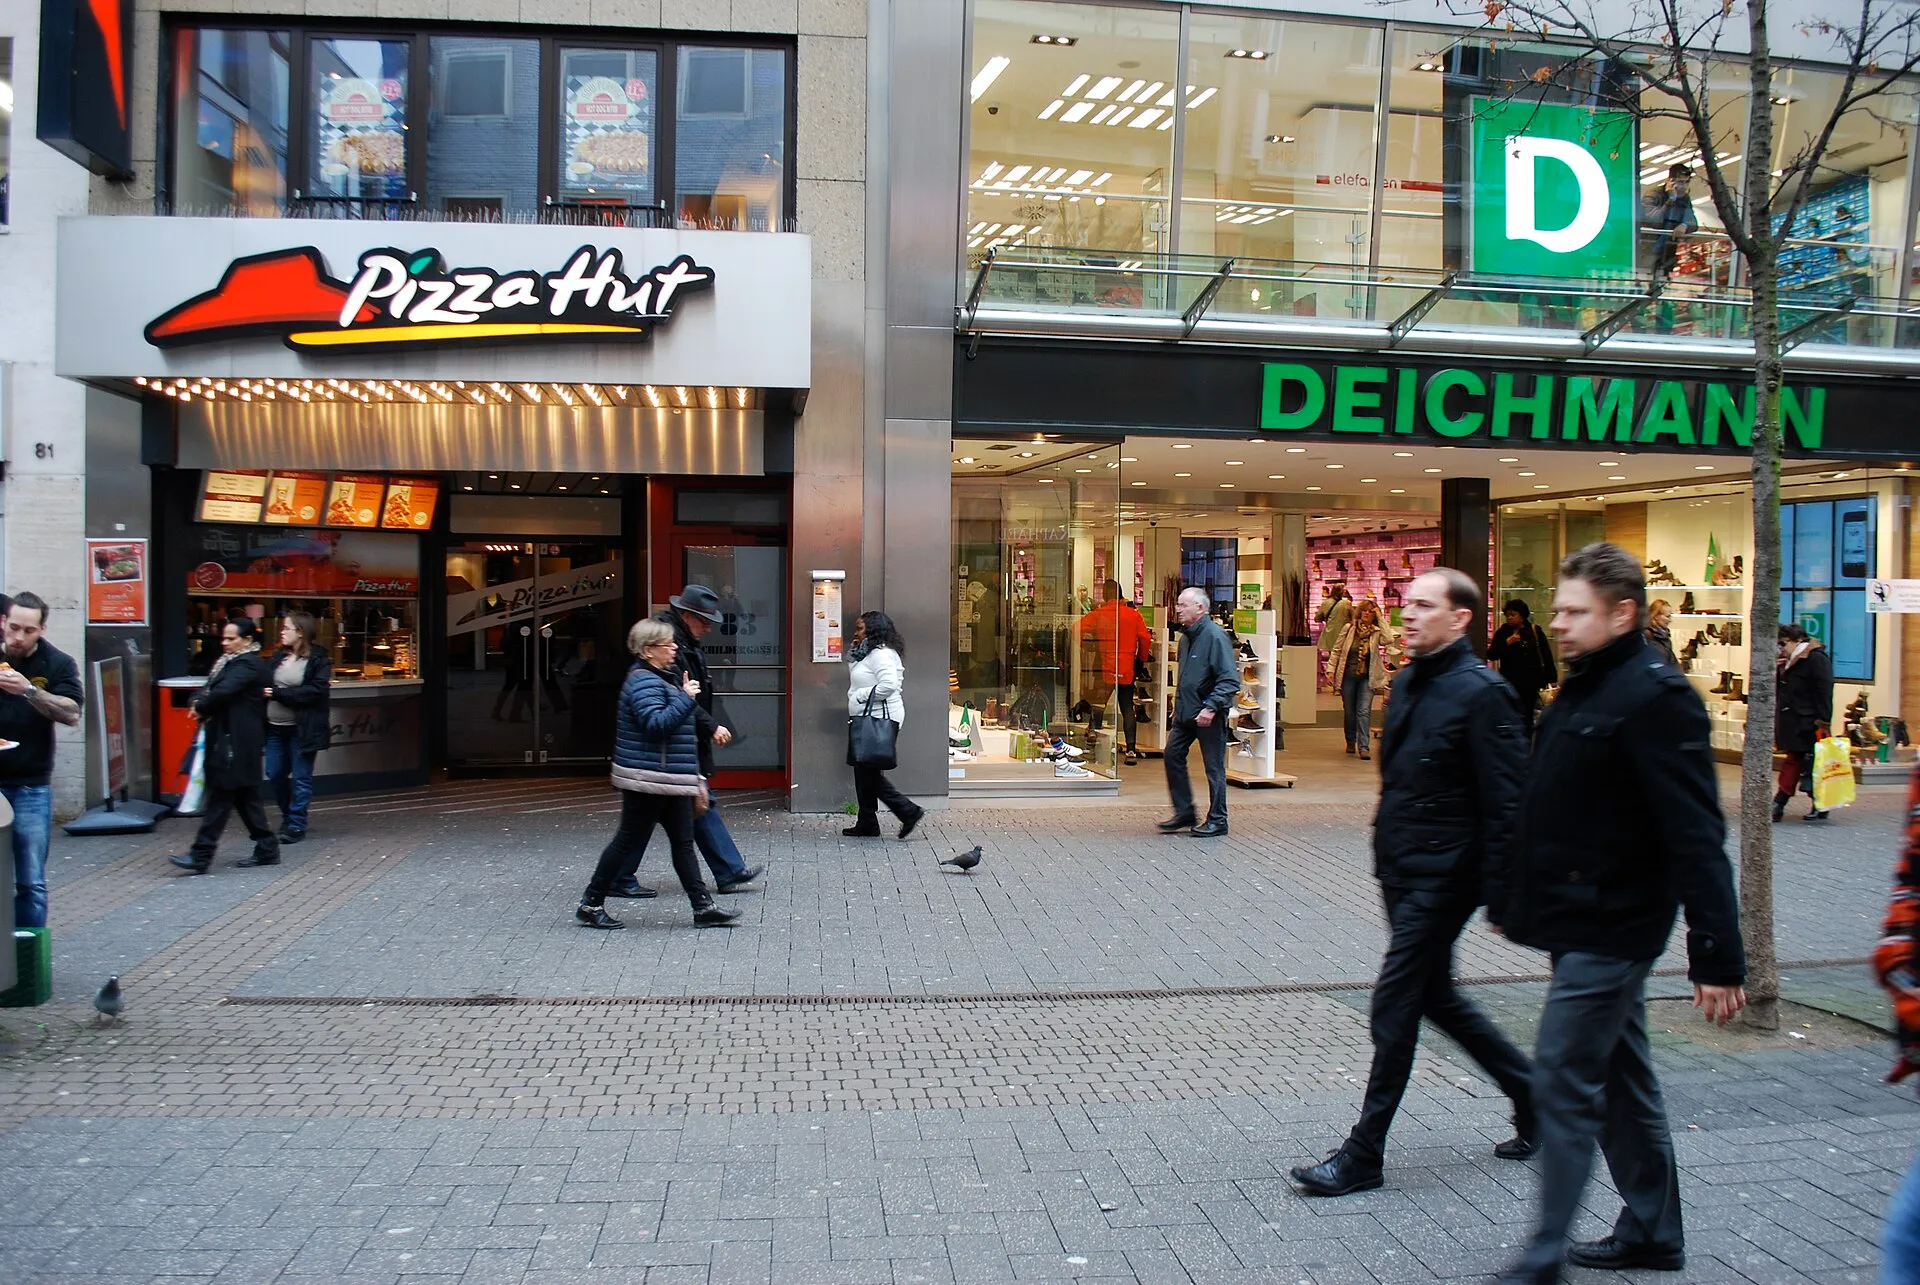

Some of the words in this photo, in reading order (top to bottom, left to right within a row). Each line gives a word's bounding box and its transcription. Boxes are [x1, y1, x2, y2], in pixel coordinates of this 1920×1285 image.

[1334, 173, 1397, 189] elefaen
[1505, 135, 1610, 253] D
[340, 254, 540, 328] Pizza
[549, 251, 708, 316] Hut
[1260, 362, 1826, 449] DEICHMANN
[35, 442, 53, 459] 81
[353, 579, 387, 593] Pizza
[388, 579, 412, 591] Hut
[720, 612, 757, 635] 83
[701, 645, 780, 655] CHILDERGASSE
